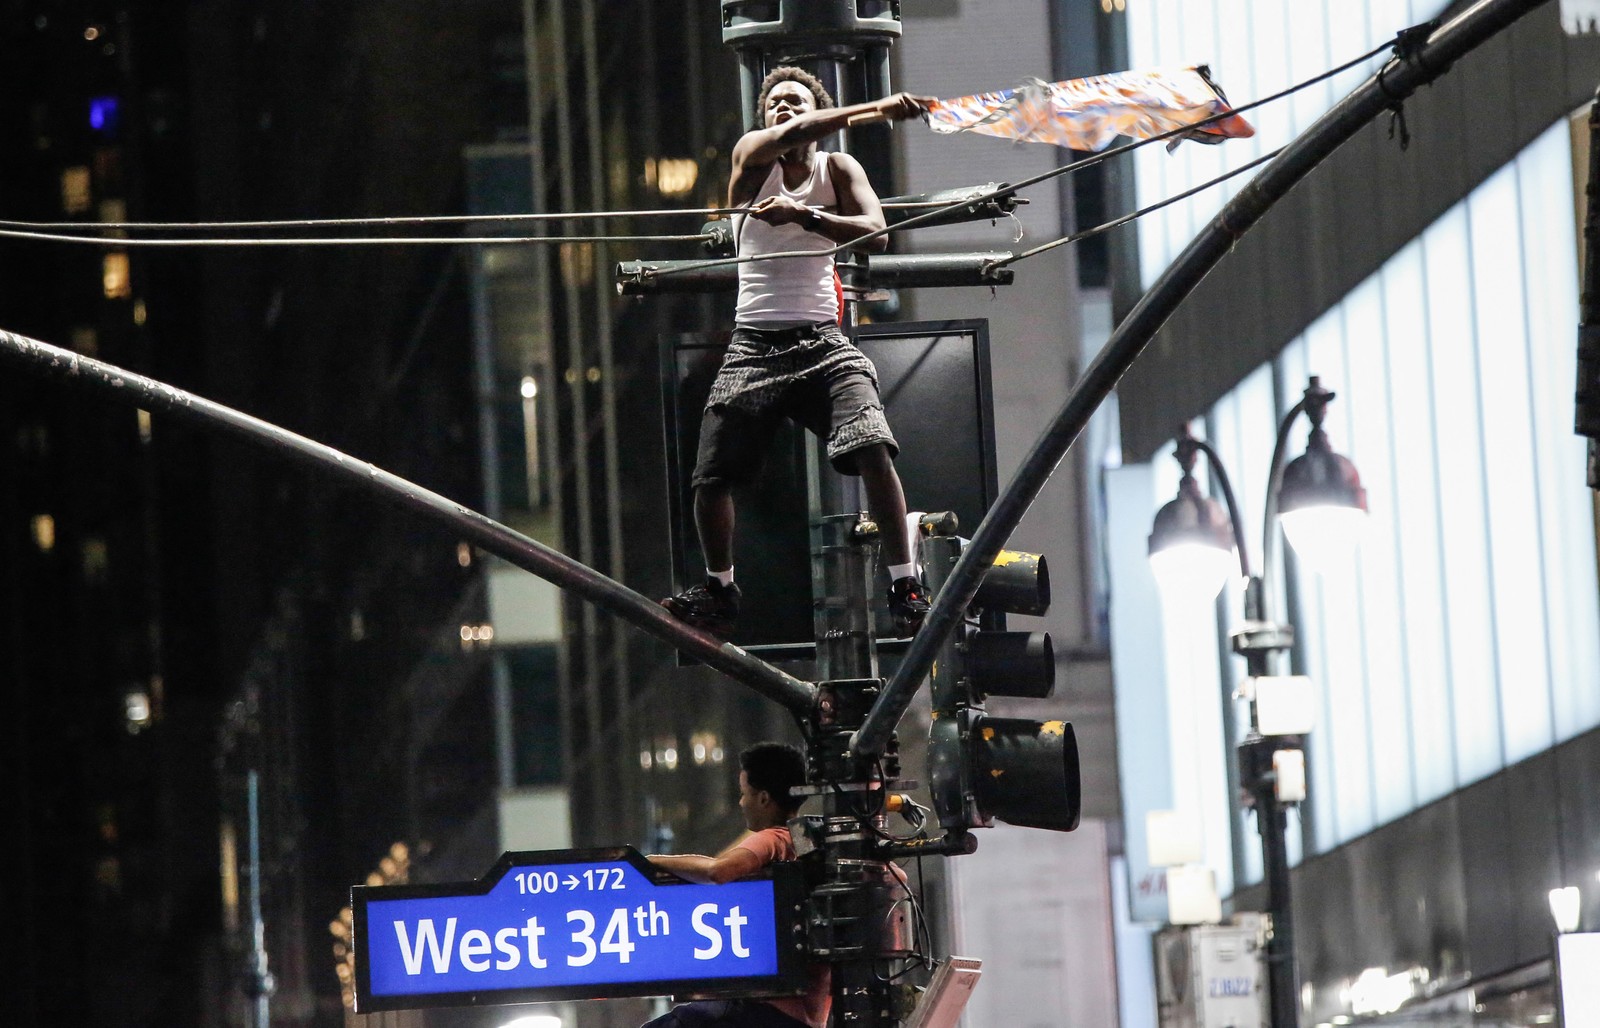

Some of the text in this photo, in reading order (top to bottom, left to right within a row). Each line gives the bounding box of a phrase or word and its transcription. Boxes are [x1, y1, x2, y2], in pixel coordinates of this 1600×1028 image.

[394, 901, 750, 976] West 34th St
